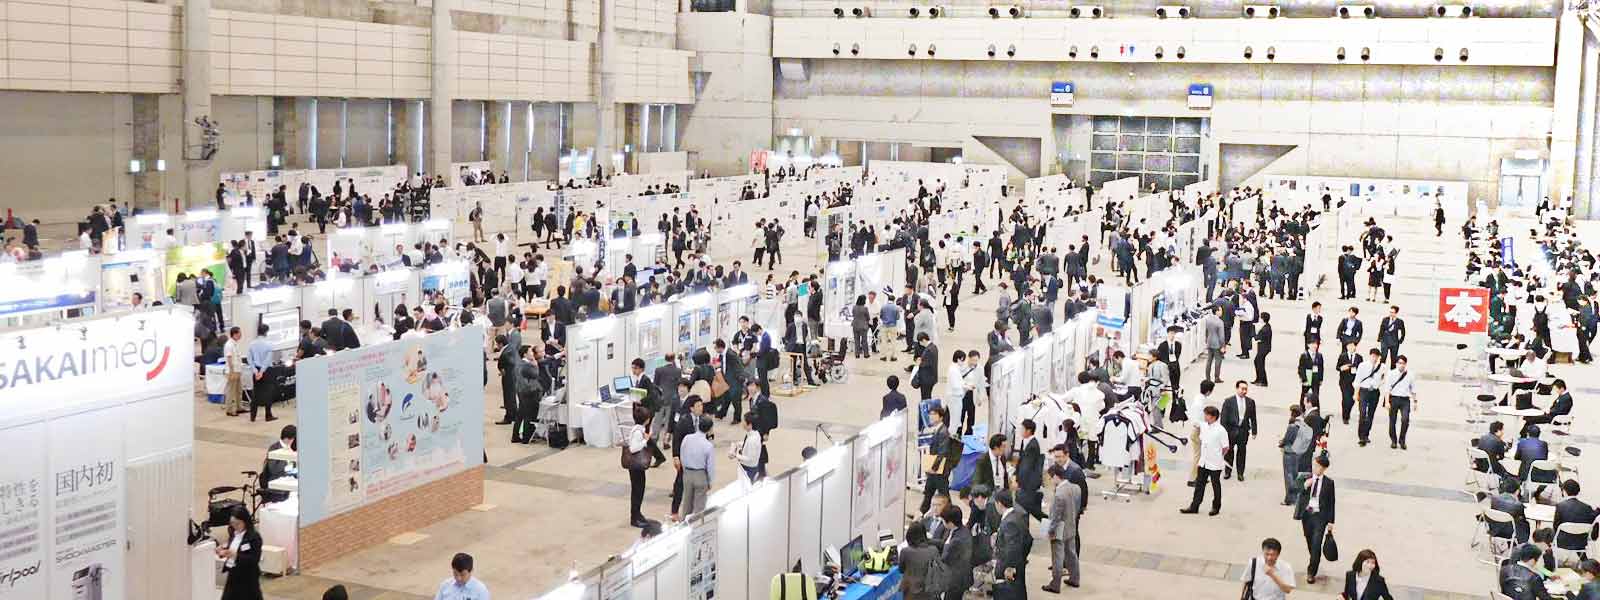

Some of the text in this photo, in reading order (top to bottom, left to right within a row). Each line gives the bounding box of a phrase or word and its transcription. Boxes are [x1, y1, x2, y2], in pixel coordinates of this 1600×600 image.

[1444, 291, 1483, 329] 本
[56, 461, 113, 497] 国内初
